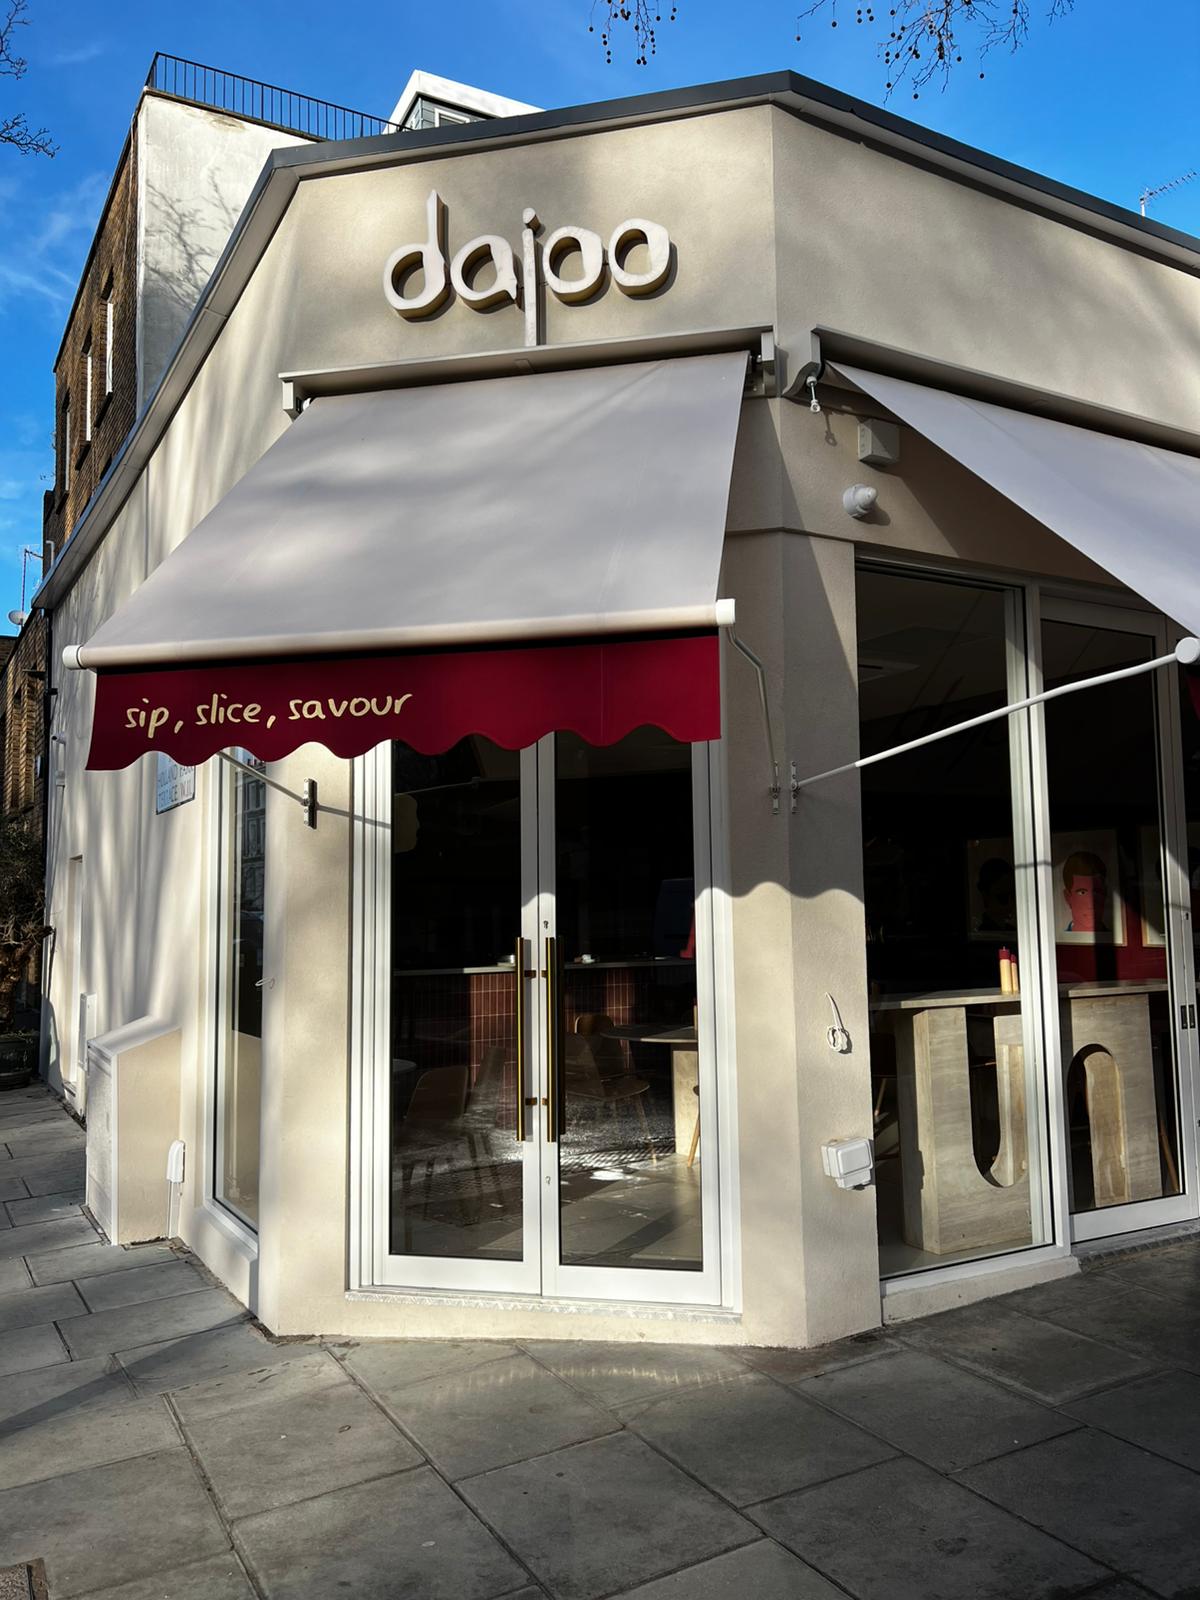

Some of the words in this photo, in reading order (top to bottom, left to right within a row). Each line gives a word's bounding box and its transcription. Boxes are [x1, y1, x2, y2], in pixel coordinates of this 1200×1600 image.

[383, 189, 670, 346] dajoo
[125, 698, 184, 738] sip,
[196, 693, 276, 729] slice,
[288, 693, 413, 720] savour
